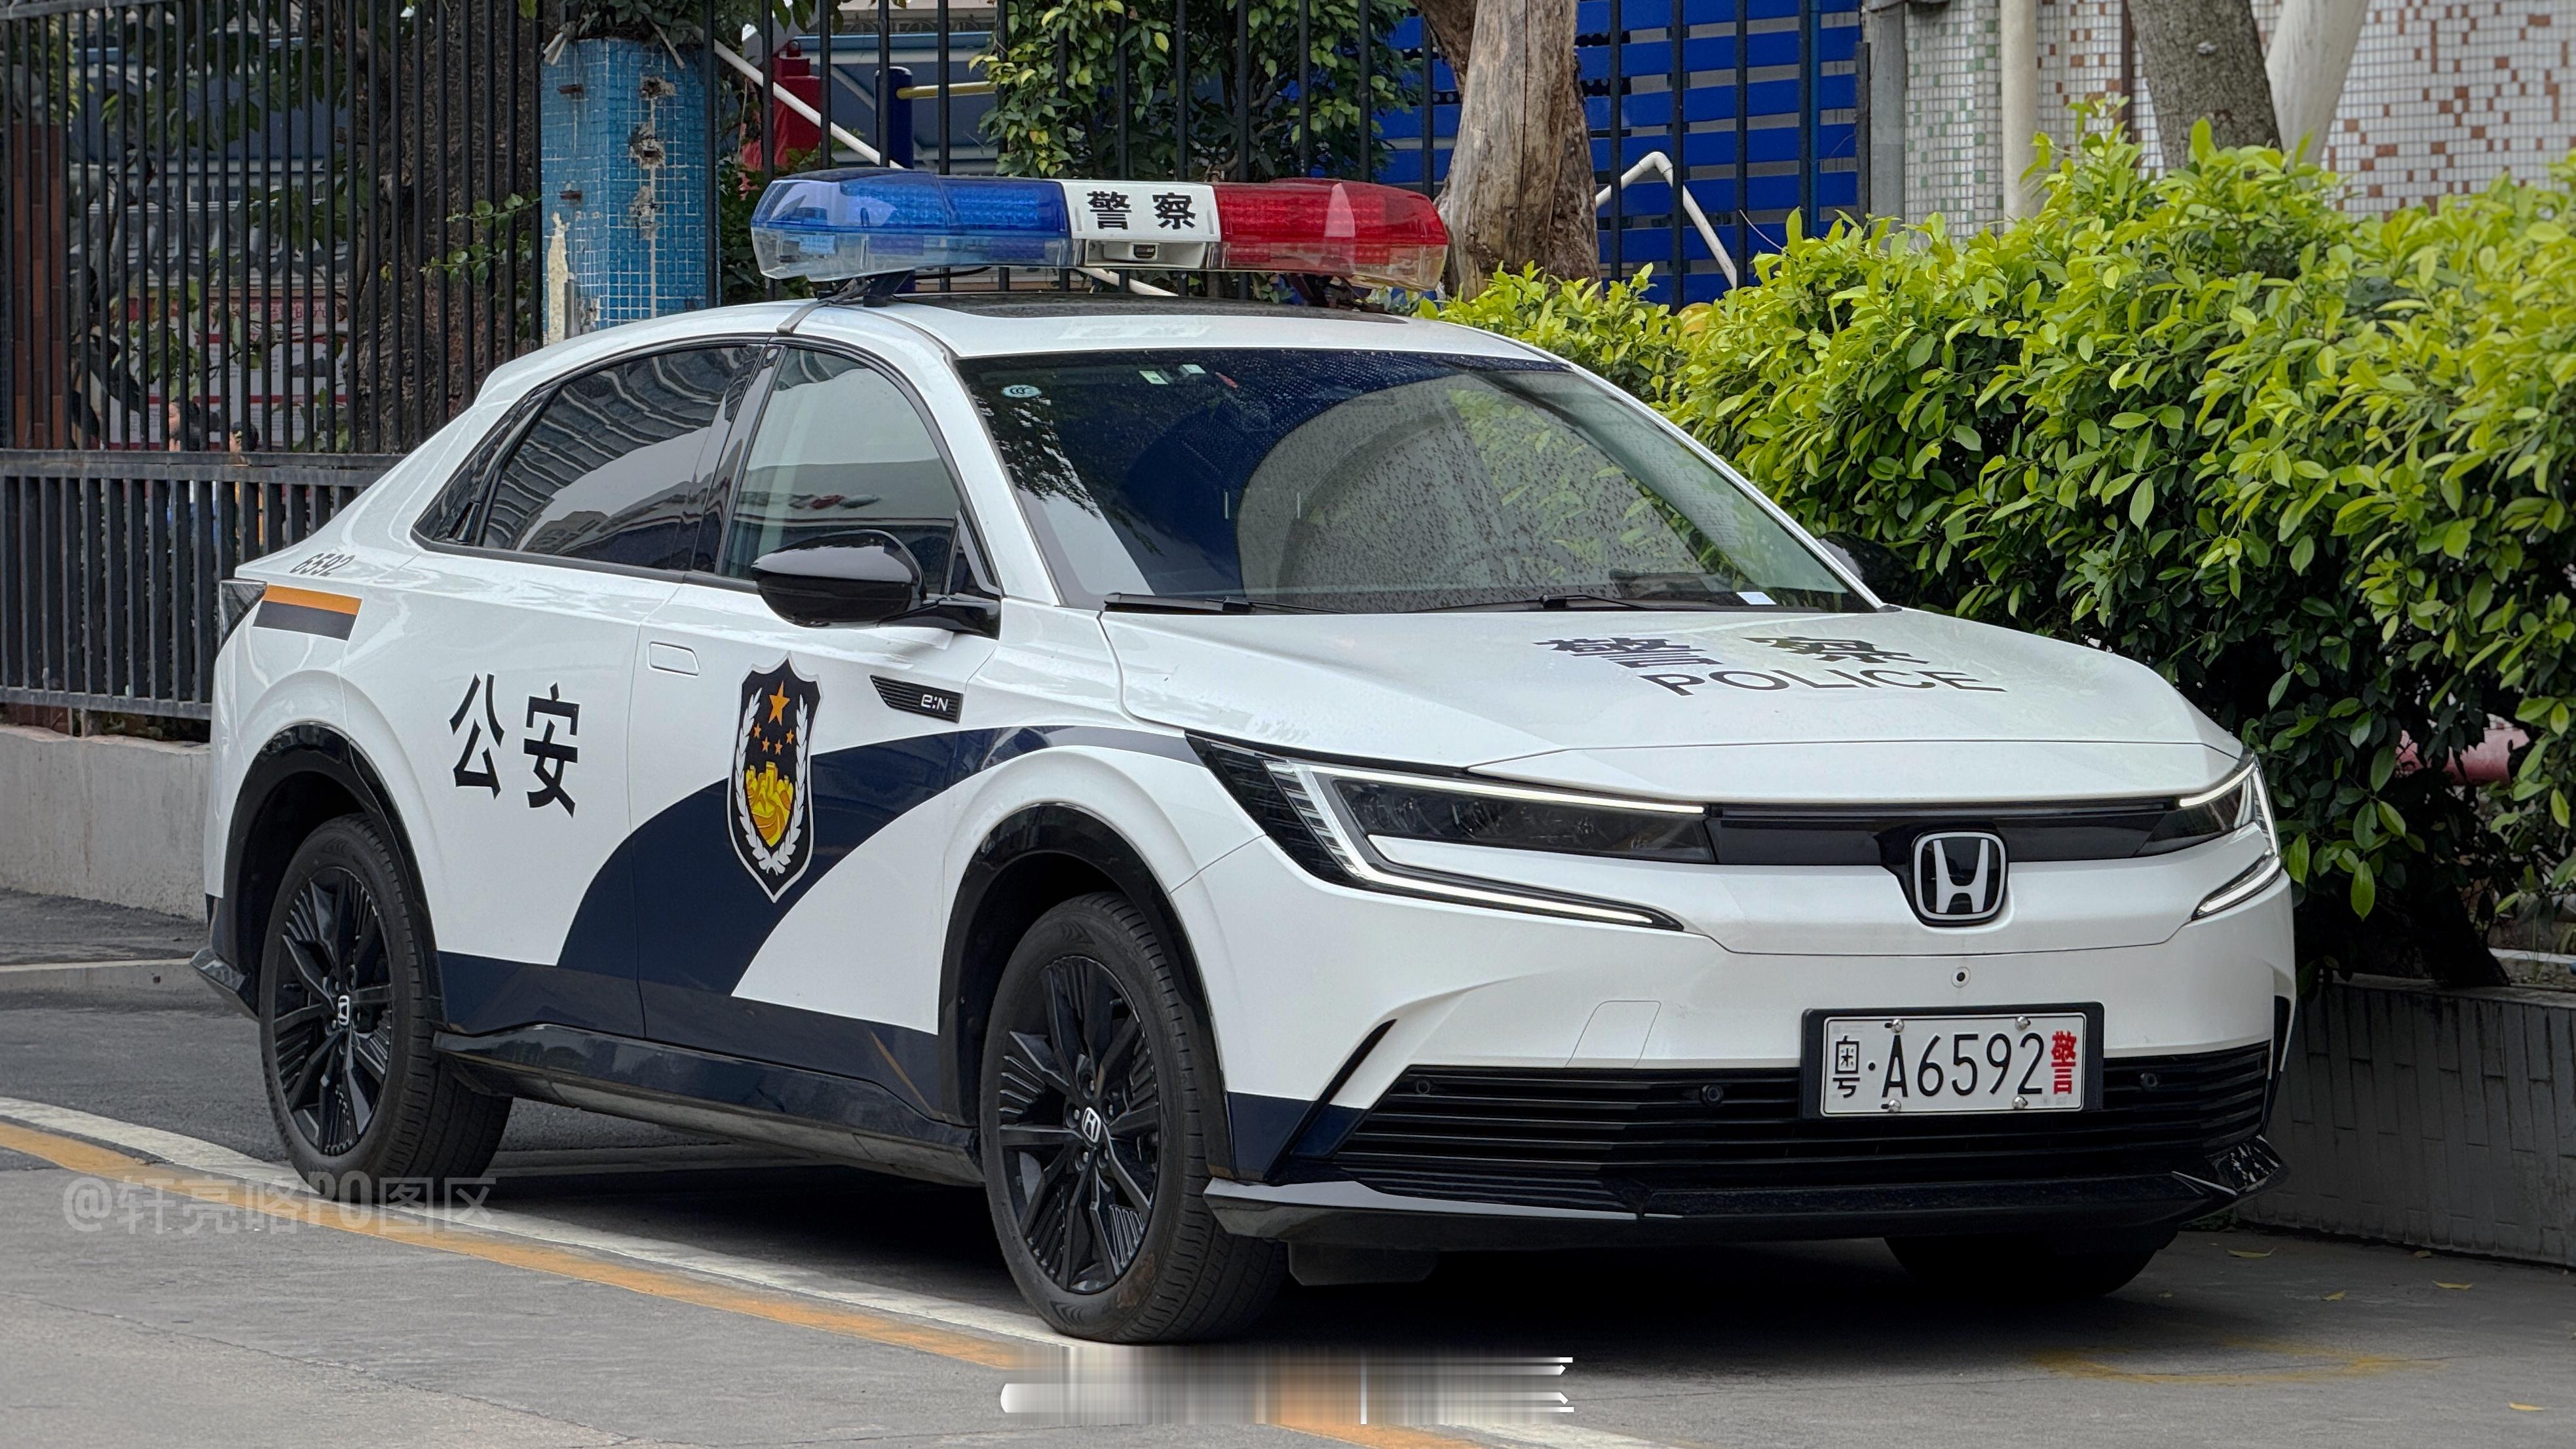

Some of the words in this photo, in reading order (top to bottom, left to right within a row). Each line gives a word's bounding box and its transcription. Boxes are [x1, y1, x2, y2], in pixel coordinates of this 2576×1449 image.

[1087, 191, 1197, 231] 警察
[289, 552, 356, 576] 6592
[1533, 636, 1930, 668] 警察
[1638, 669, 2007, 696] POLICE
[448, 673, 580, 818] 公安
